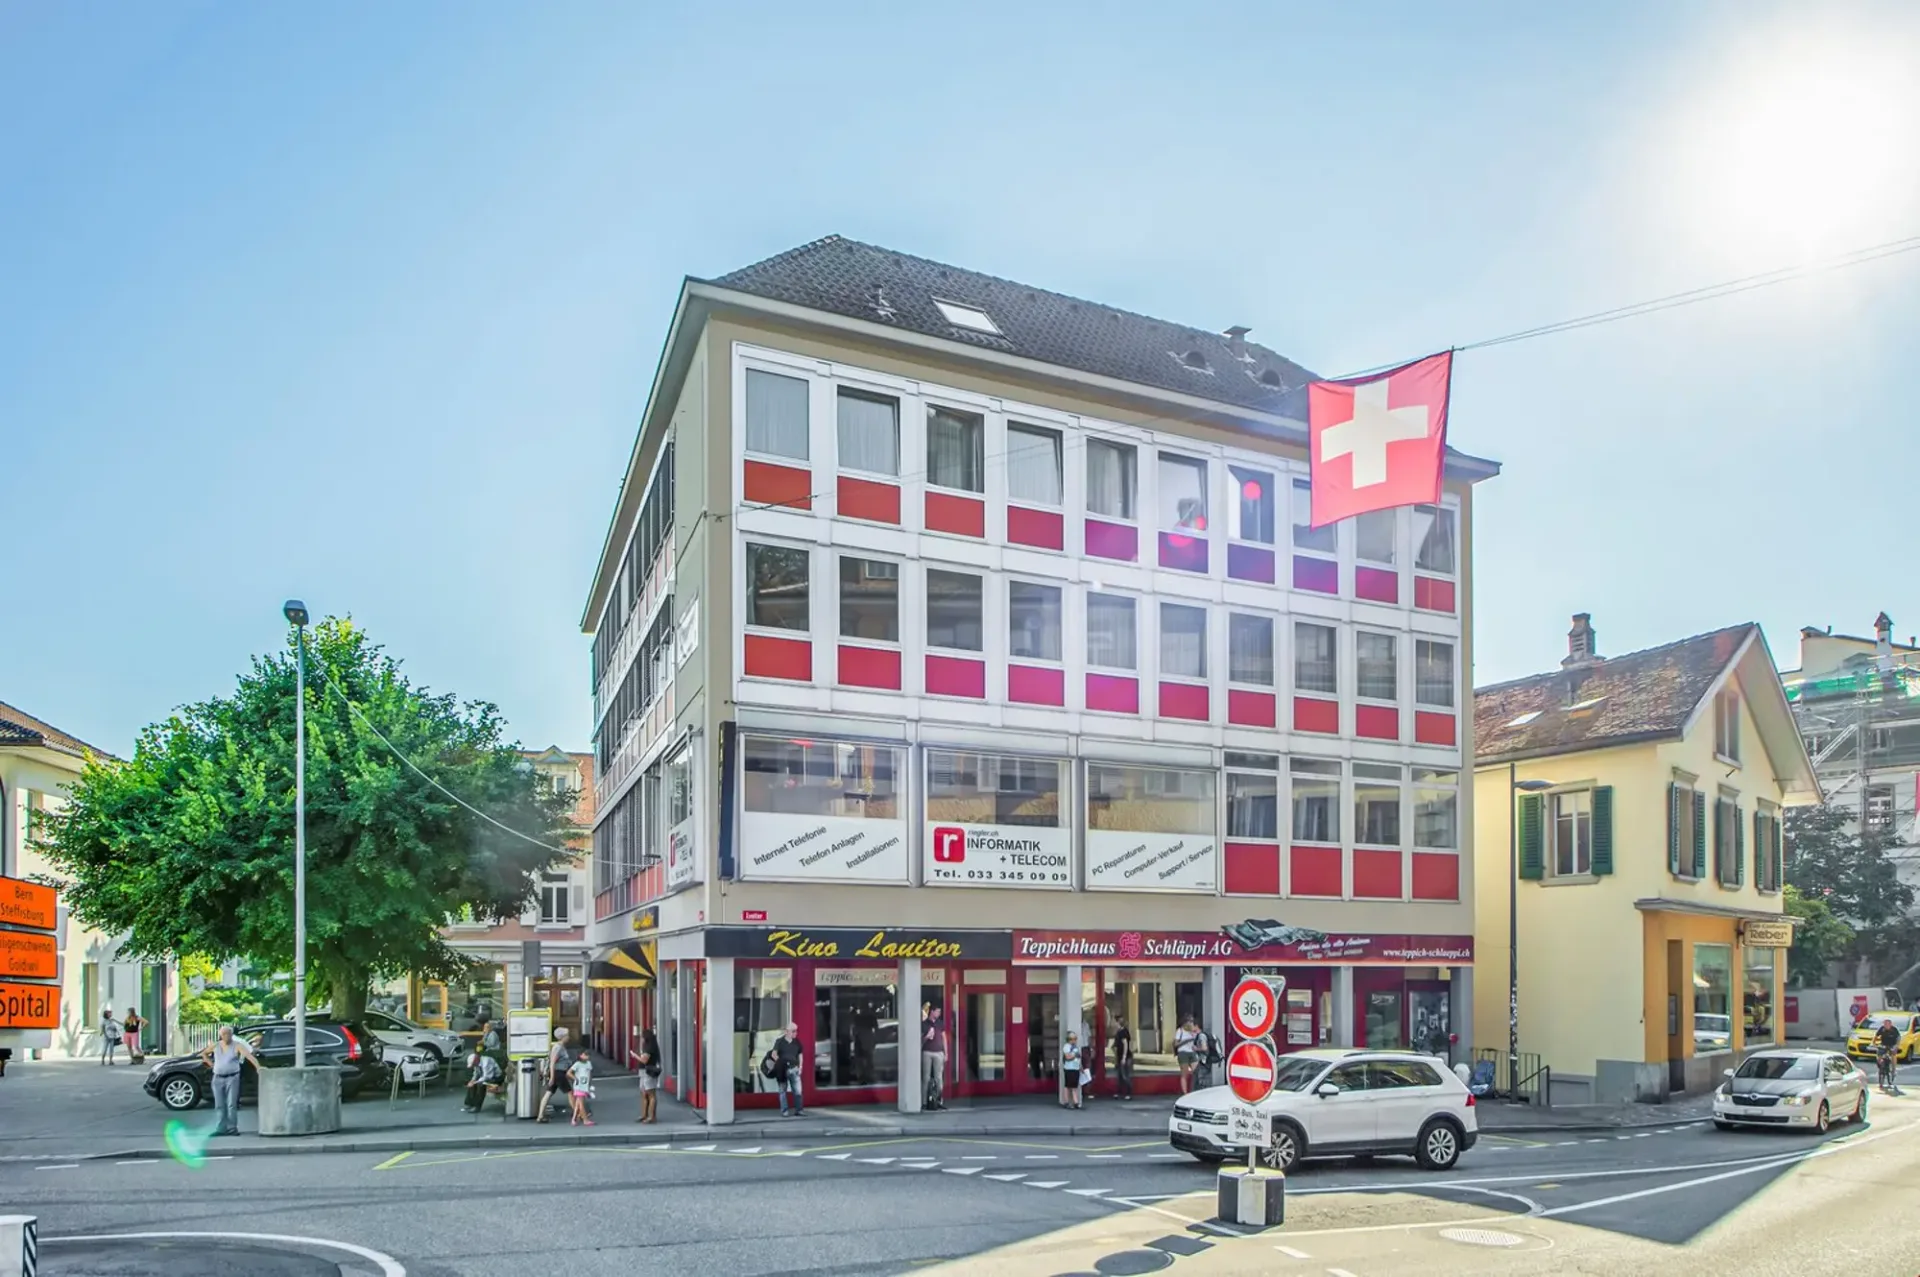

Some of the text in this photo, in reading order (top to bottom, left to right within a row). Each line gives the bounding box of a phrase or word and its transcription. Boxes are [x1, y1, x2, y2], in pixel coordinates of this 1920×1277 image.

[753, 825, 827, 866] Internet Telefonie
[799, 831, 865, 868] Telefon Anlagen
[845, 836, 900, 869] Installationen
[967, 837, 1041, 852] INFORMATIK
[1000, 854, 1067, 867] + TELECOM
[1092, 844, 1147, 876] PC Reparaturen
[1124, 840, 1185, 879] Computer-Verkauf
[1158, 859, 1186, 880] Support
[1188, 844, 1213, 864] Service
[934, 869, 1068, 882] Tel. 033 345 09 09
[14, 885, 34, 901] Bern
[0, 902, 44, 925] Steffisburg
[767, 930, 962, 958] Kino Lauitor
[1749, 929, 1788, 940] Reber
[1020, 937, 1233, 959] Teppichhaus Schläppi AG
[1256, 1109, 1268, 1120] Taxi
[1235, 1131, 1263, 1141] gestattet
